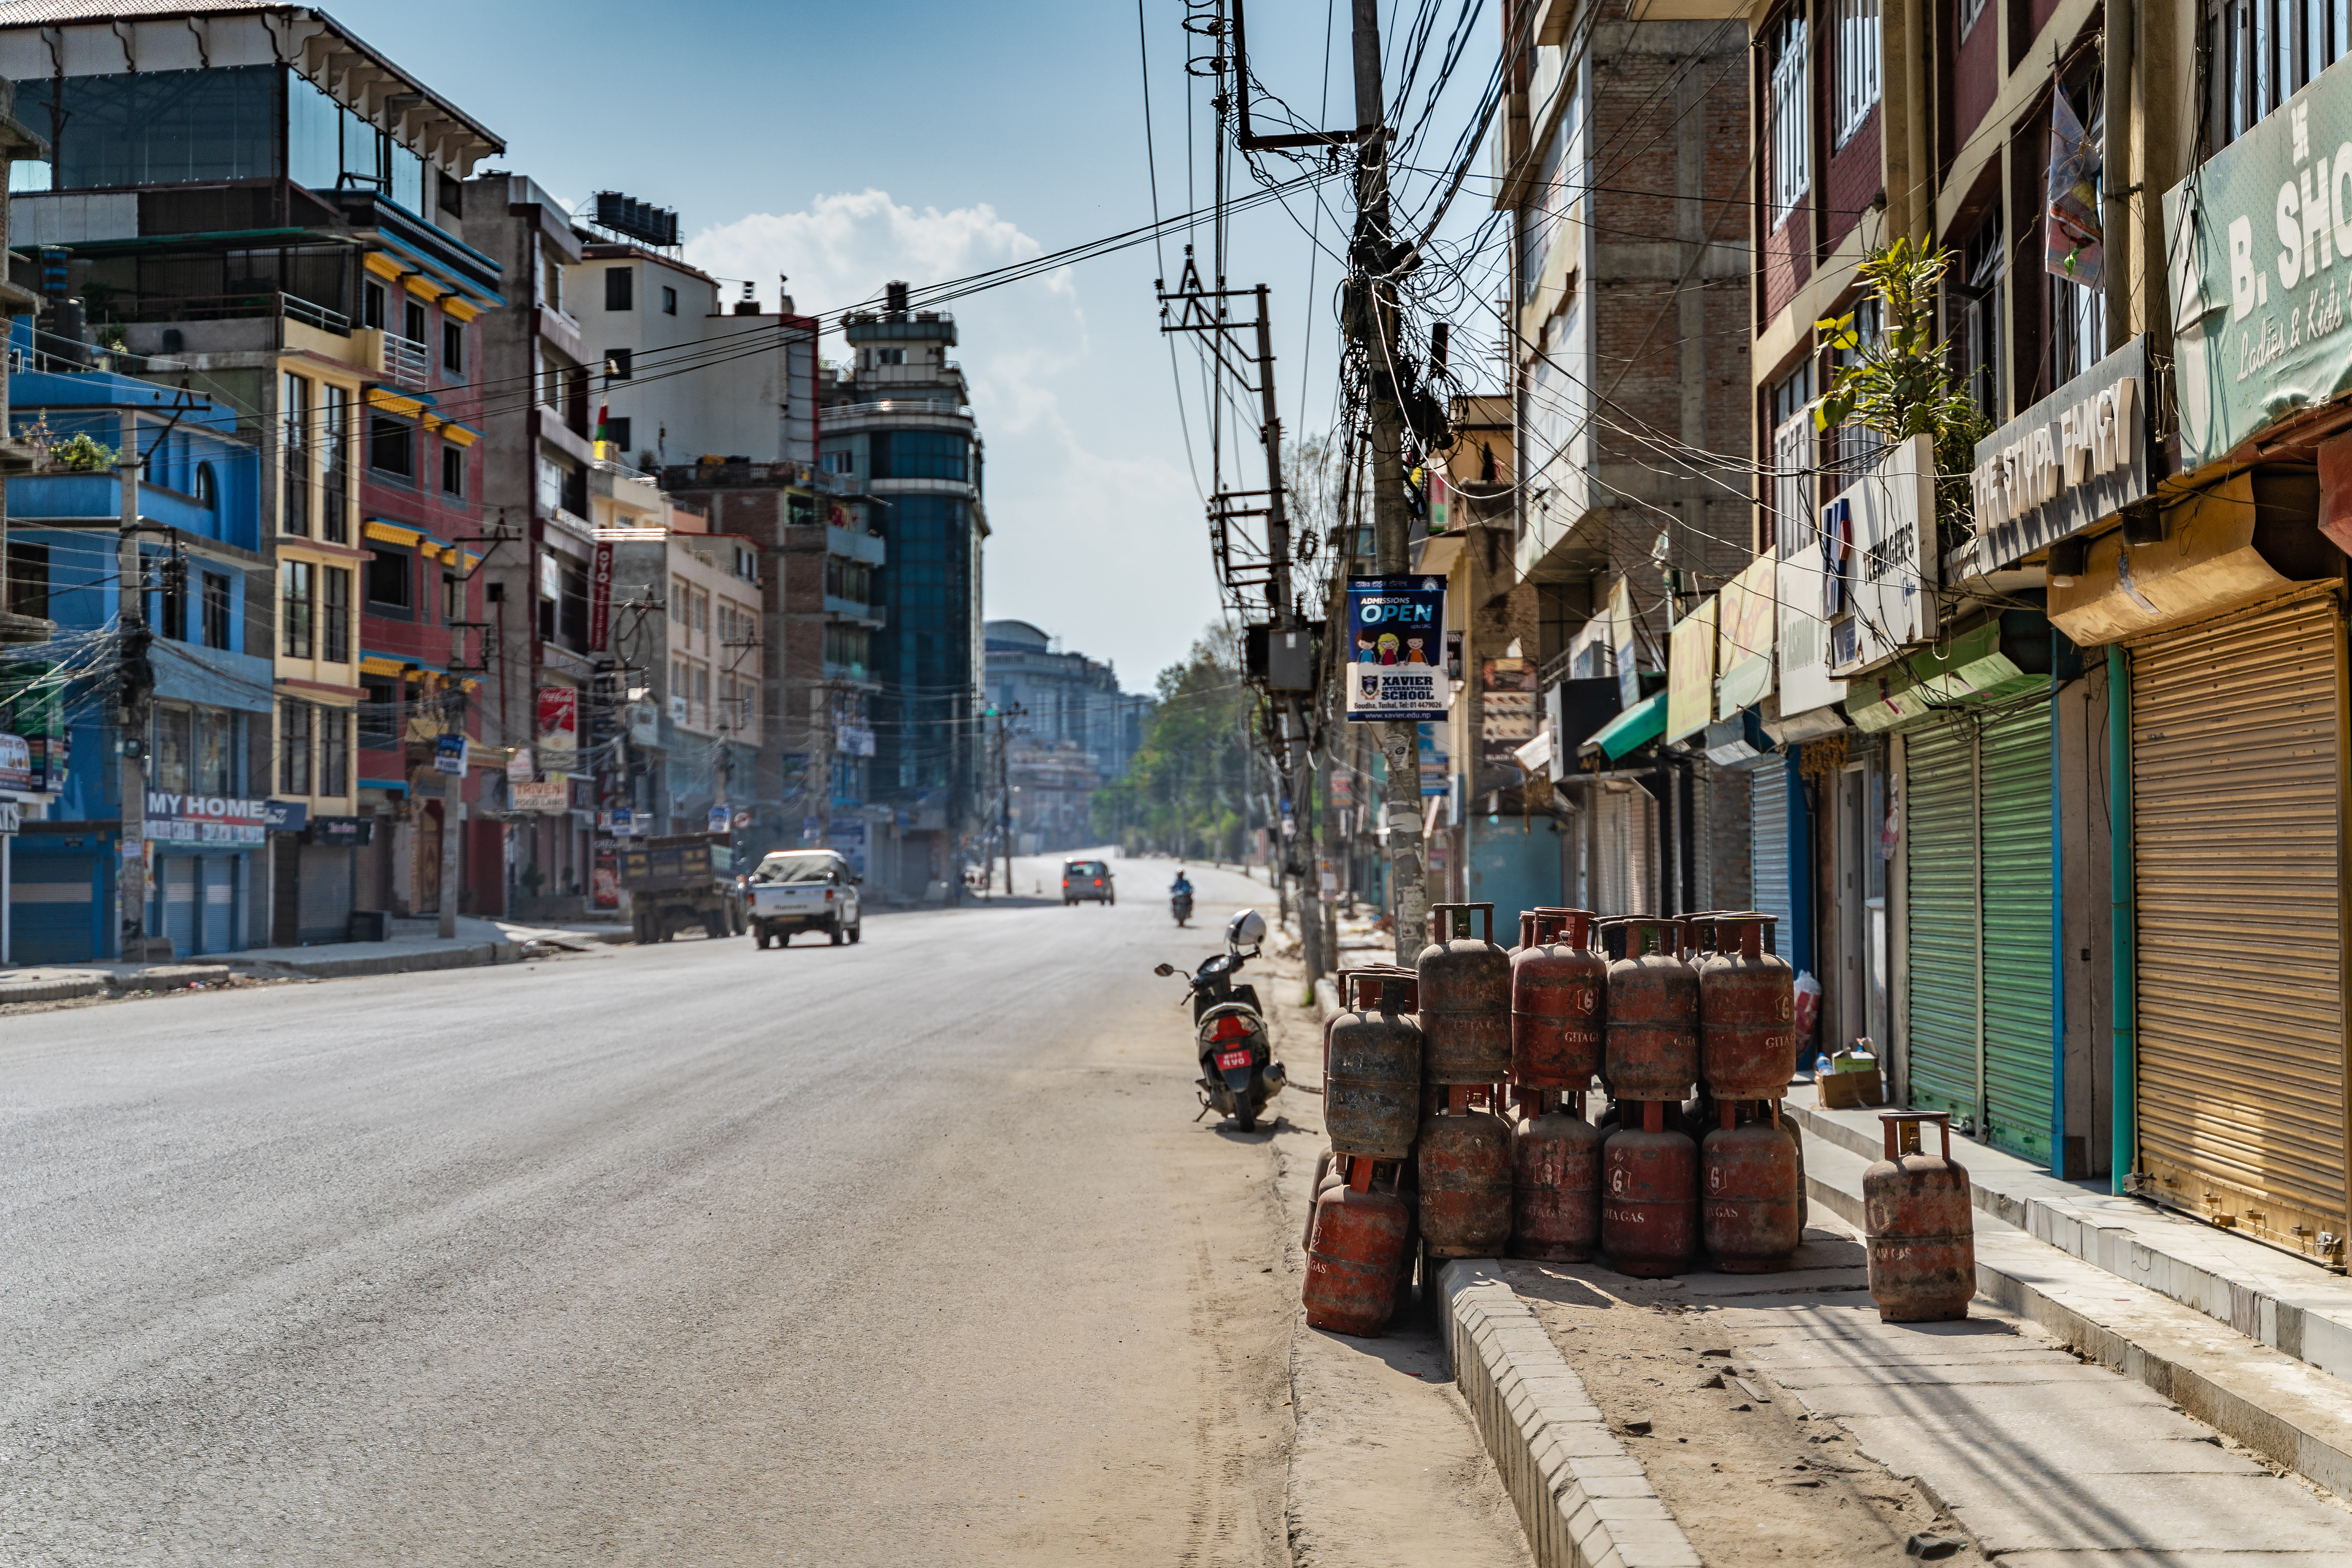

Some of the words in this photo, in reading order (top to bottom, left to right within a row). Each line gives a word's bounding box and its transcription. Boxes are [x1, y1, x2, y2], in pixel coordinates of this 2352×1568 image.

[2229, 214, 2267, 323] B.
[2237, 317, 2285, 383] Ladies
[2290, 307, 2301, 348] &
[2307, 278, 2343, 341] Kids
[1970, 454, 2006, 536] THE
[2003, 424, 2060, 519] STUPA
[2061, 377, 2134, 492] FANCY
[1863, 521, 1914, 586] TEENAGER'S
[597, 550, 609, 582] OYO
[1361, 604, 1433, 622] OPEN
[1382, 676, 1434, 686] XAVIER
[1381, 691, 1435, 701] SCHOOL
[148, 792, 182, 815] MY
[187, 798, 265, 818] HOME
[1565, 1032, 1588, 1042] GITA
[1420, 1195, 1433, 1205] GAS
[1621, 1211, 1644, 1223] GAS
[1715, 1207, 1738, 1218] GAS
[1311, 1261, 1327, 1274] GAS
